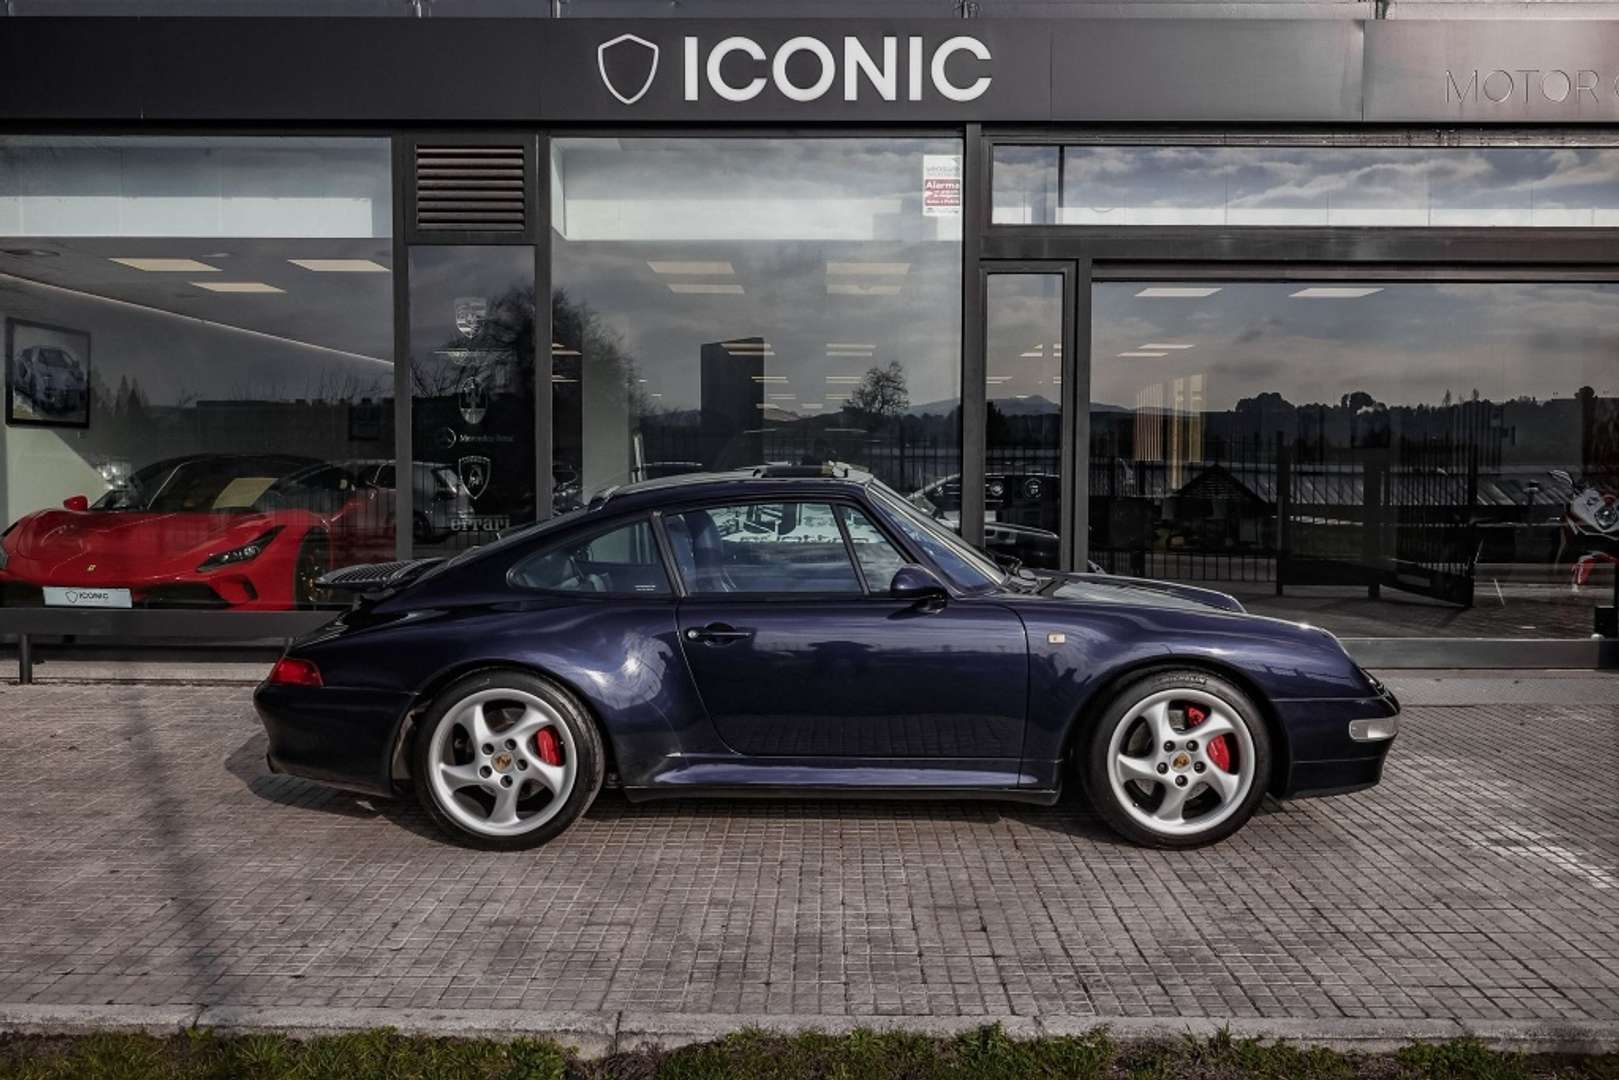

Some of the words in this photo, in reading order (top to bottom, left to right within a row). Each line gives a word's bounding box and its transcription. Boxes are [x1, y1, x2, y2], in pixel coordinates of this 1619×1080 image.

[684, 36, 993, 102] ICONIC
[1446, 69, 1600, 104] MOTOR
[449, 516, 510, 531] errari
[79, 591, 109, 600] ICONIC
